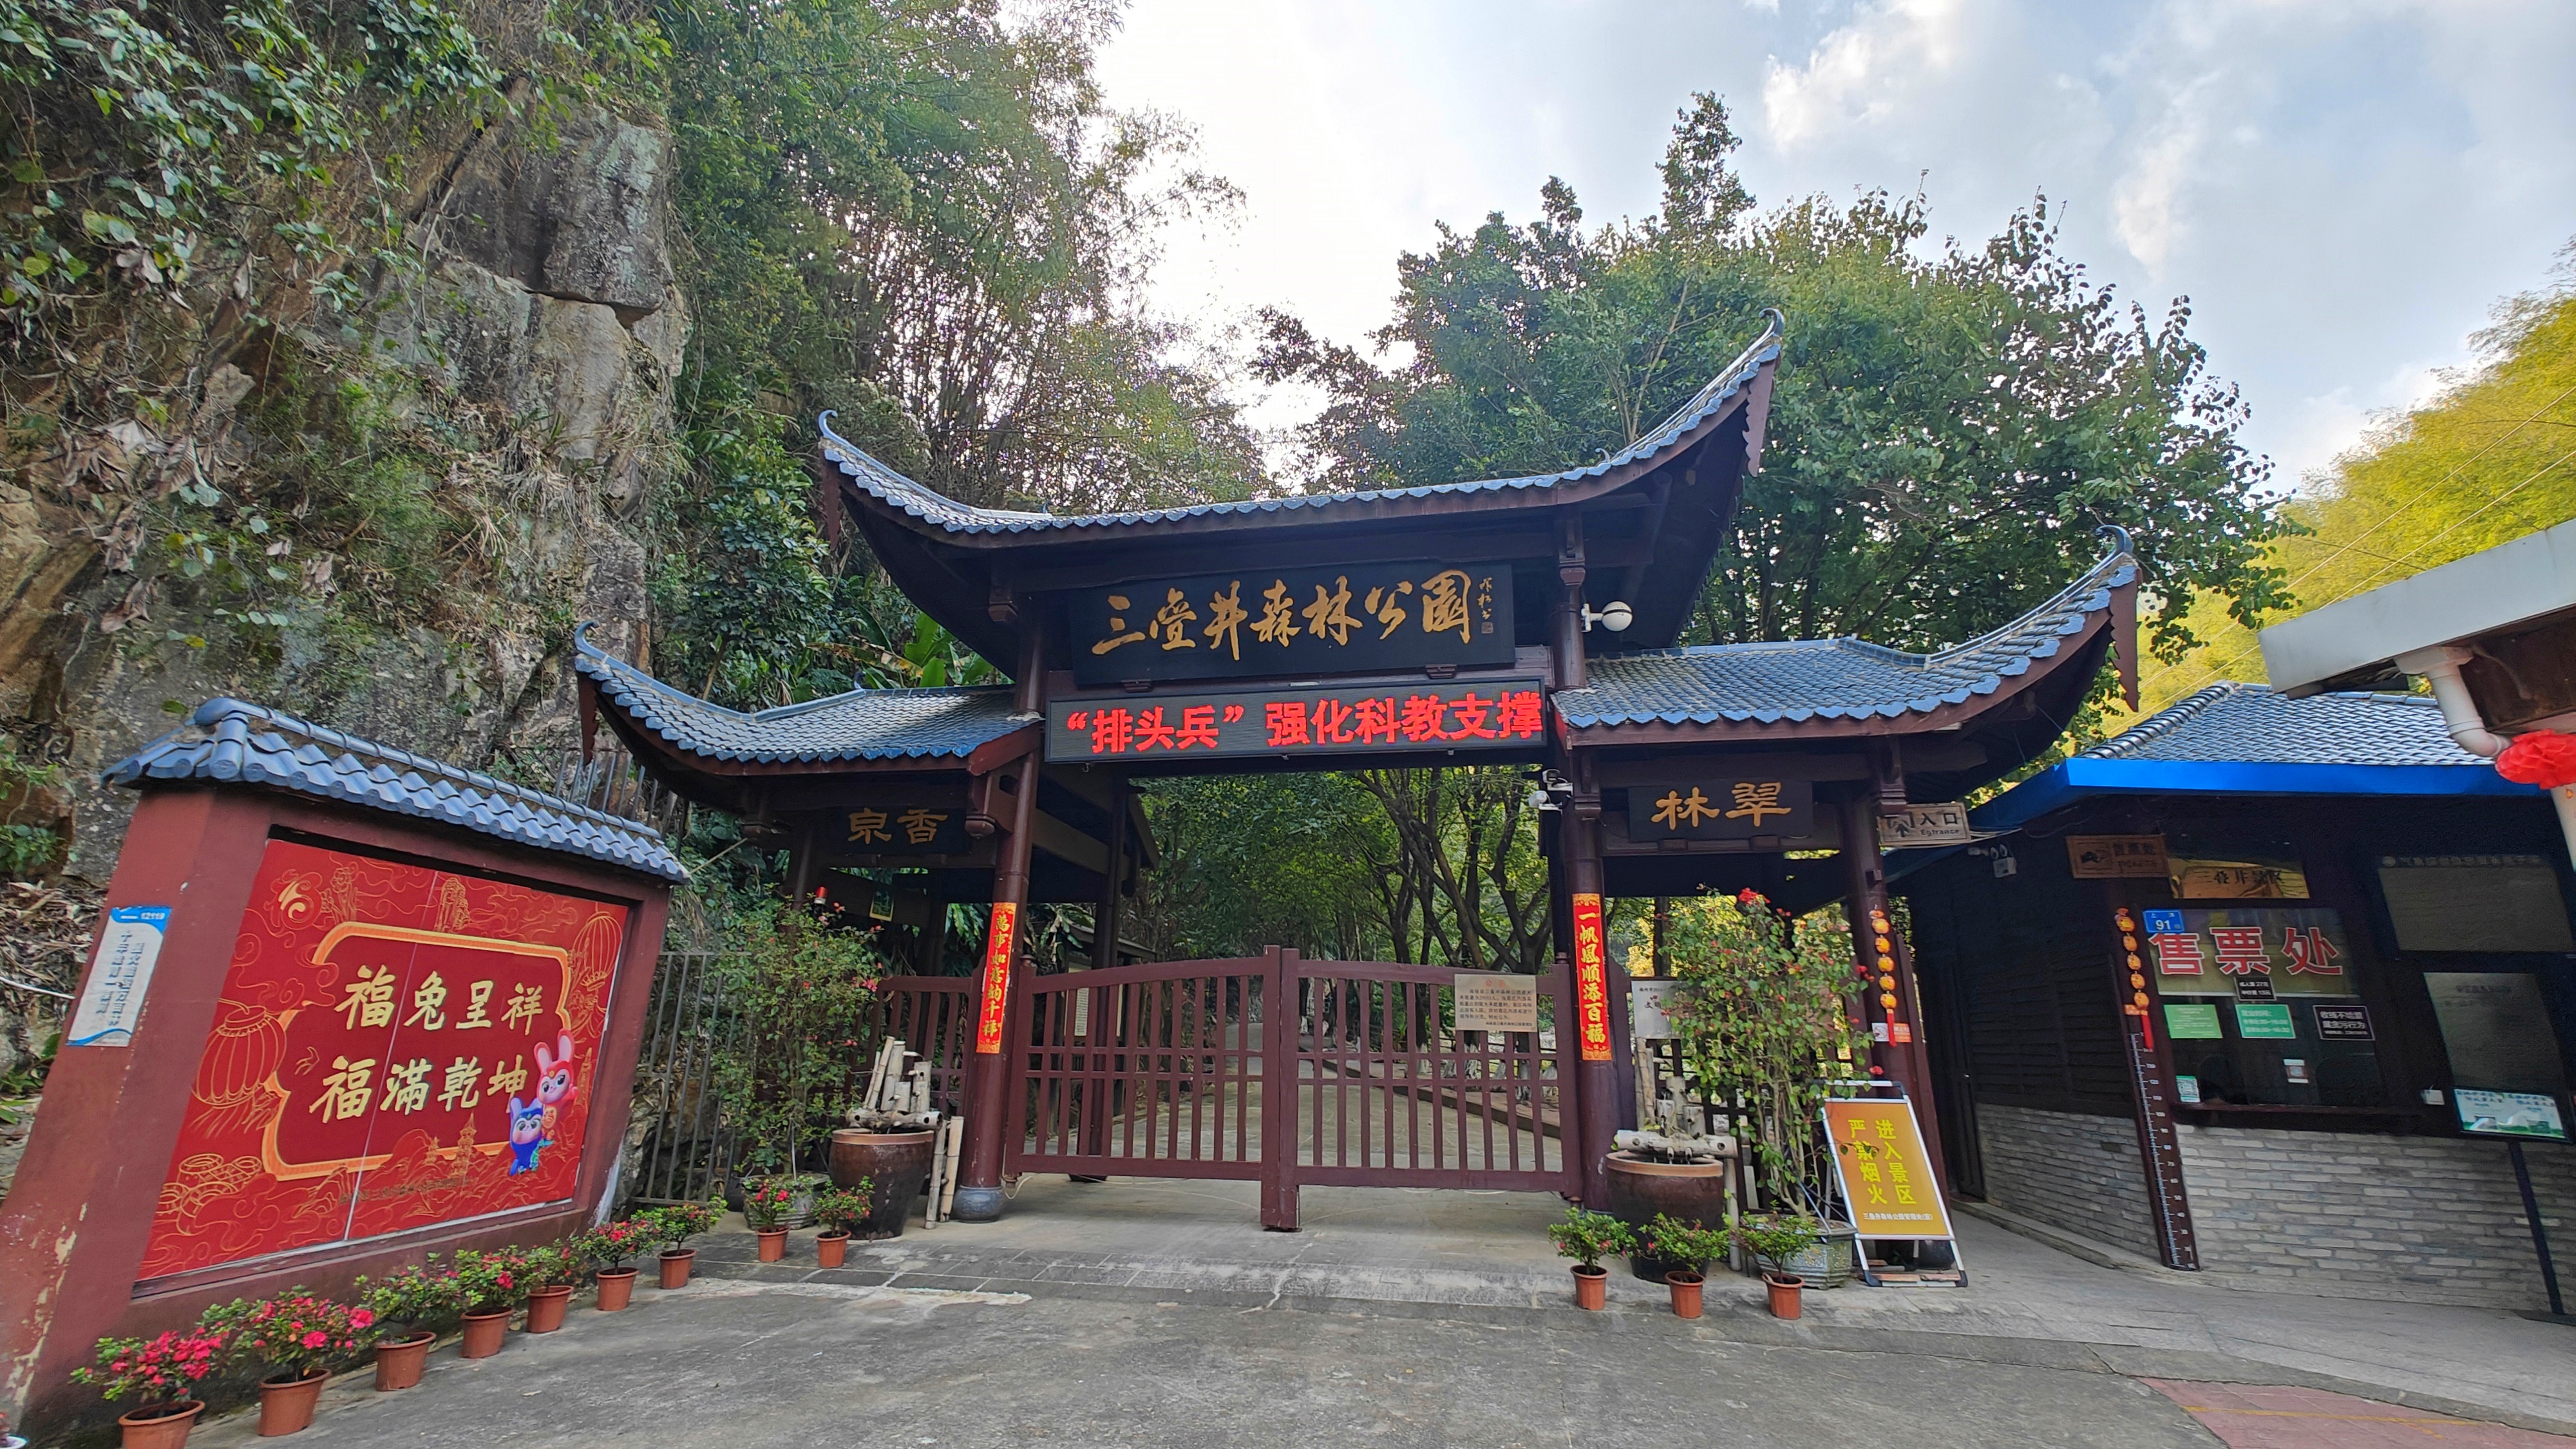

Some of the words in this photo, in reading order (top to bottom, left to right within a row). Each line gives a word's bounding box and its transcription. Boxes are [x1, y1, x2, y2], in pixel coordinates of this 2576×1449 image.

[1265, 690, 1544, 747] 强化科教支撑
[1920, 813, 1958, 826] 入口
[2148, 927, 2344, 976] 售票处
[1848, 1119, 1888, 1205] 严禁烟火
[1875, 1119, 1917, 1205] 进入景区
